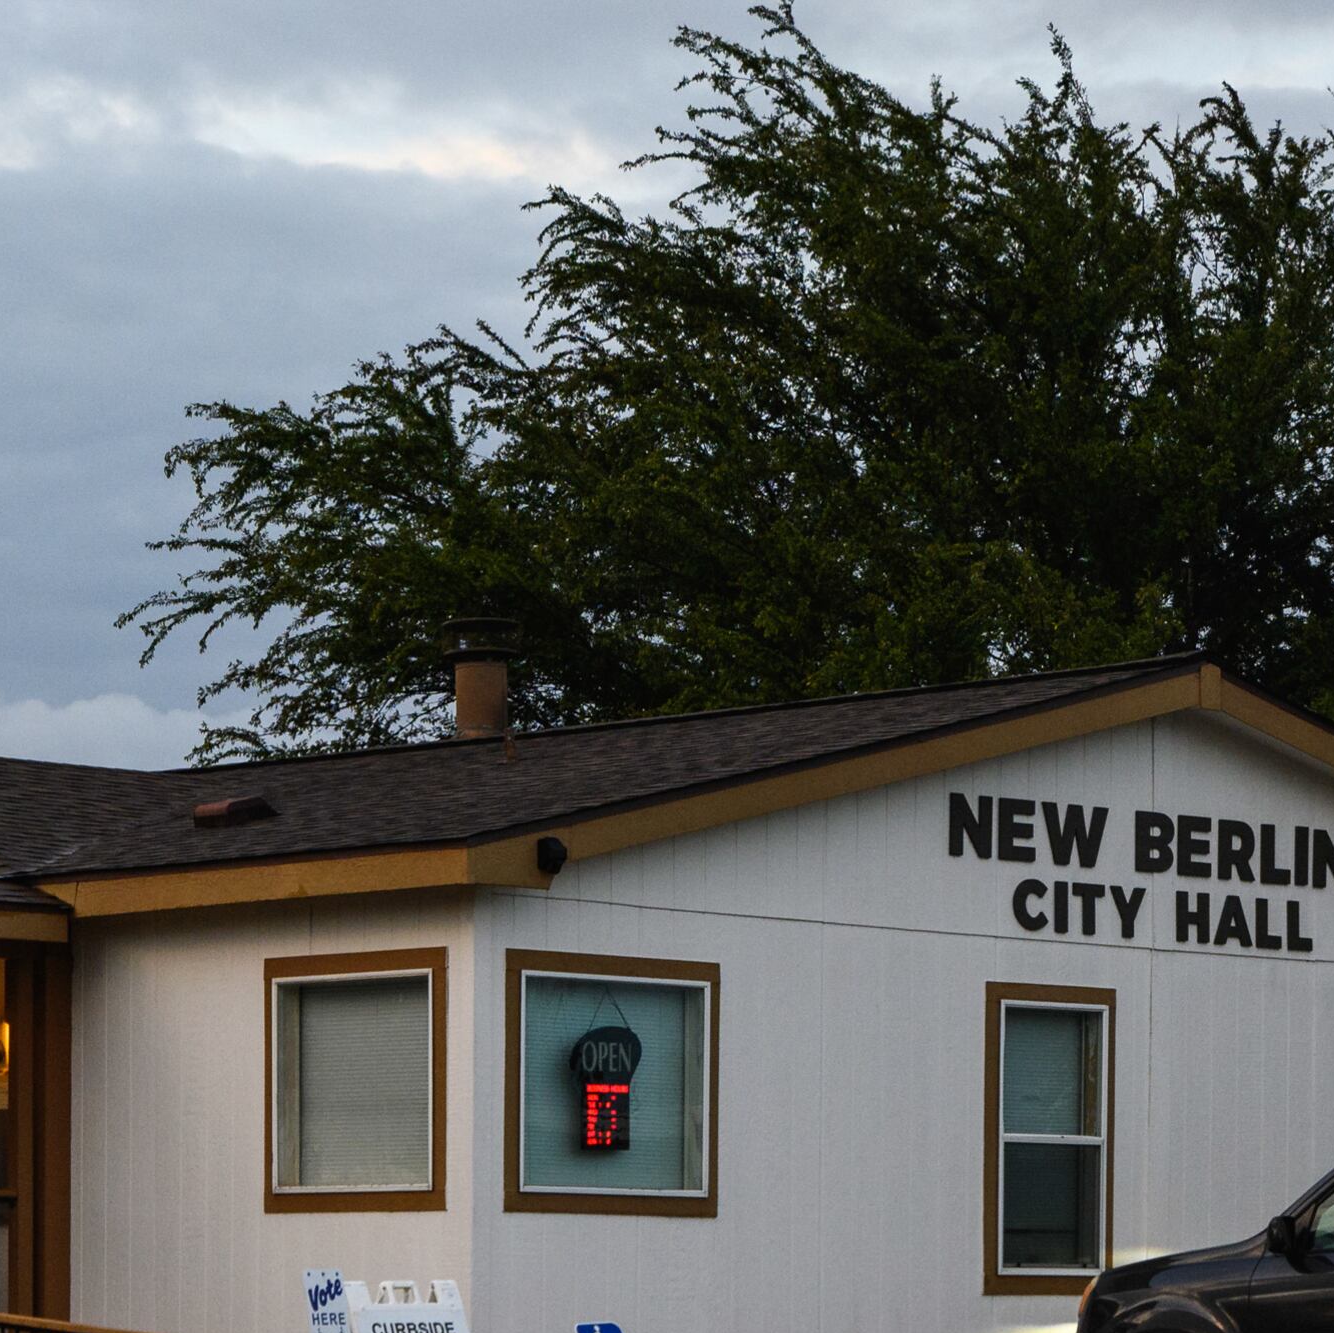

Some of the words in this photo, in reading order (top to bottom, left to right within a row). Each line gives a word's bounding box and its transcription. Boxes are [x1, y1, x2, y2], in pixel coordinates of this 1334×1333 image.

[948, 792, 1109, 868] NEW
[1012, 879, 1146, 938] CITY
[1175, 890, 1313, 952] HALL
[582, 1041, 632, 1072] OPEN
[308, 1278, 343, 1312] Vote
[312, 1312, 346, 1326] HERE
